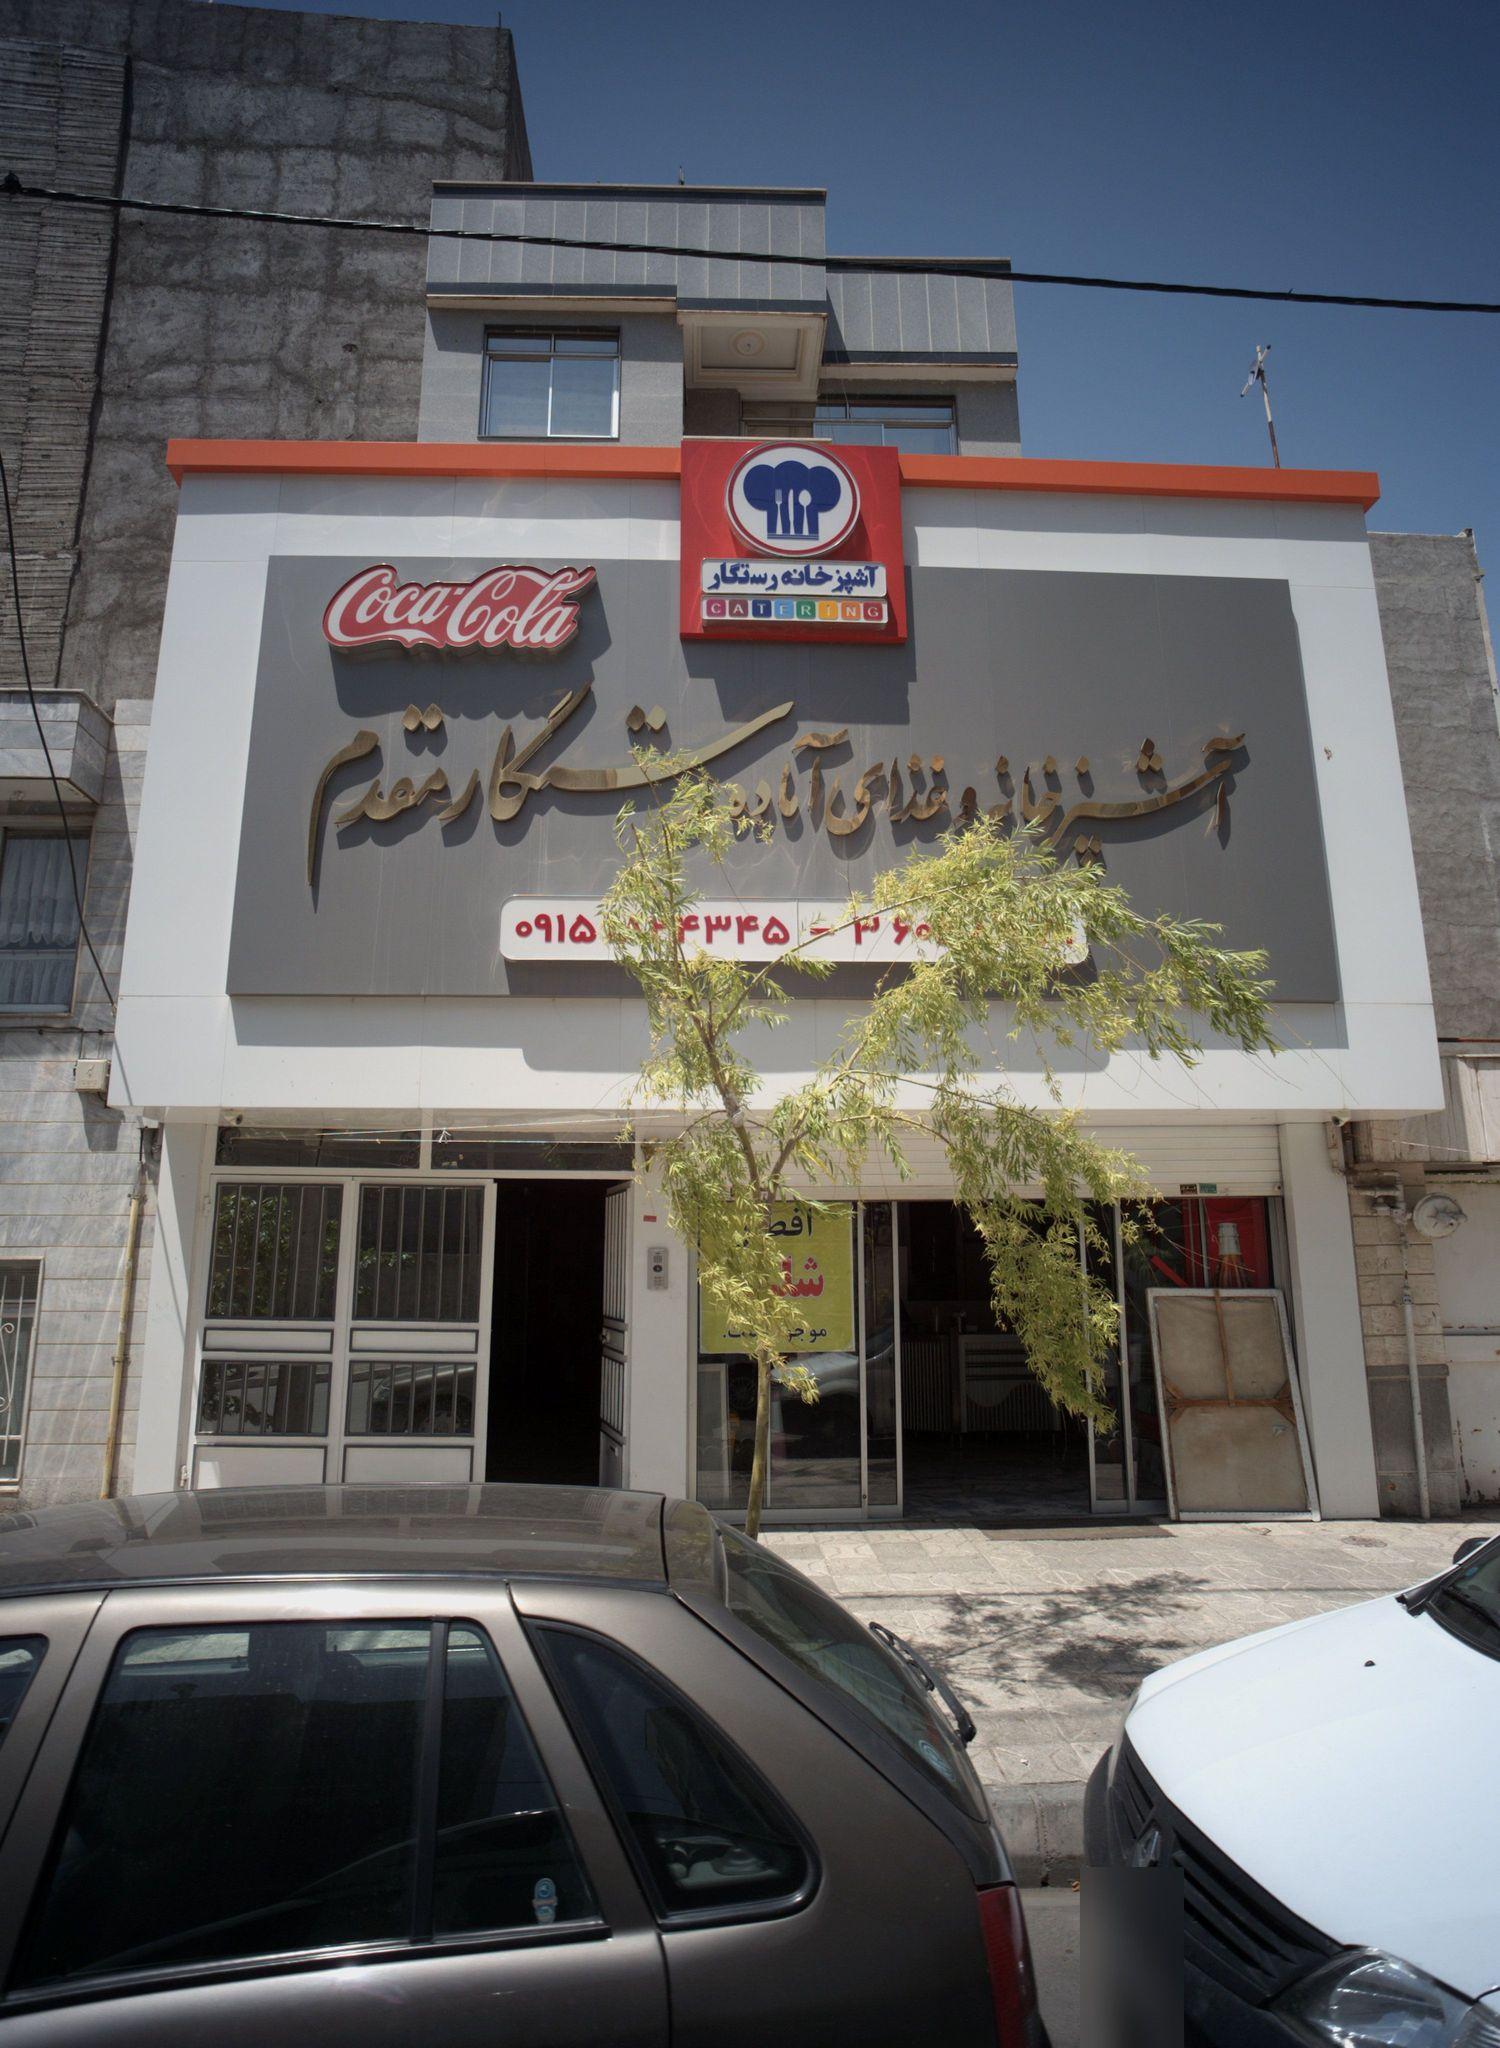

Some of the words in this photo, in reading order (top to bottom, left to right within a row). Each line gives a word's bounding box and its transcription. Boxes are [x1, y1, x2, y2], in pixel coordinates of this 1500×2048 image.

[707, 561, 779, 591] رستگار
[780, 563, 879, 595] آشپزخانه
[327, 567, 593, 644] Coca-Cola
[709, 602, 880, 618] CATERING
[438, 680, 797, 823] ستگار
[307, 703, 448, 886] مقدم
[515, 913, 790, 945] ۰۹۱۵۴۳۴۵
